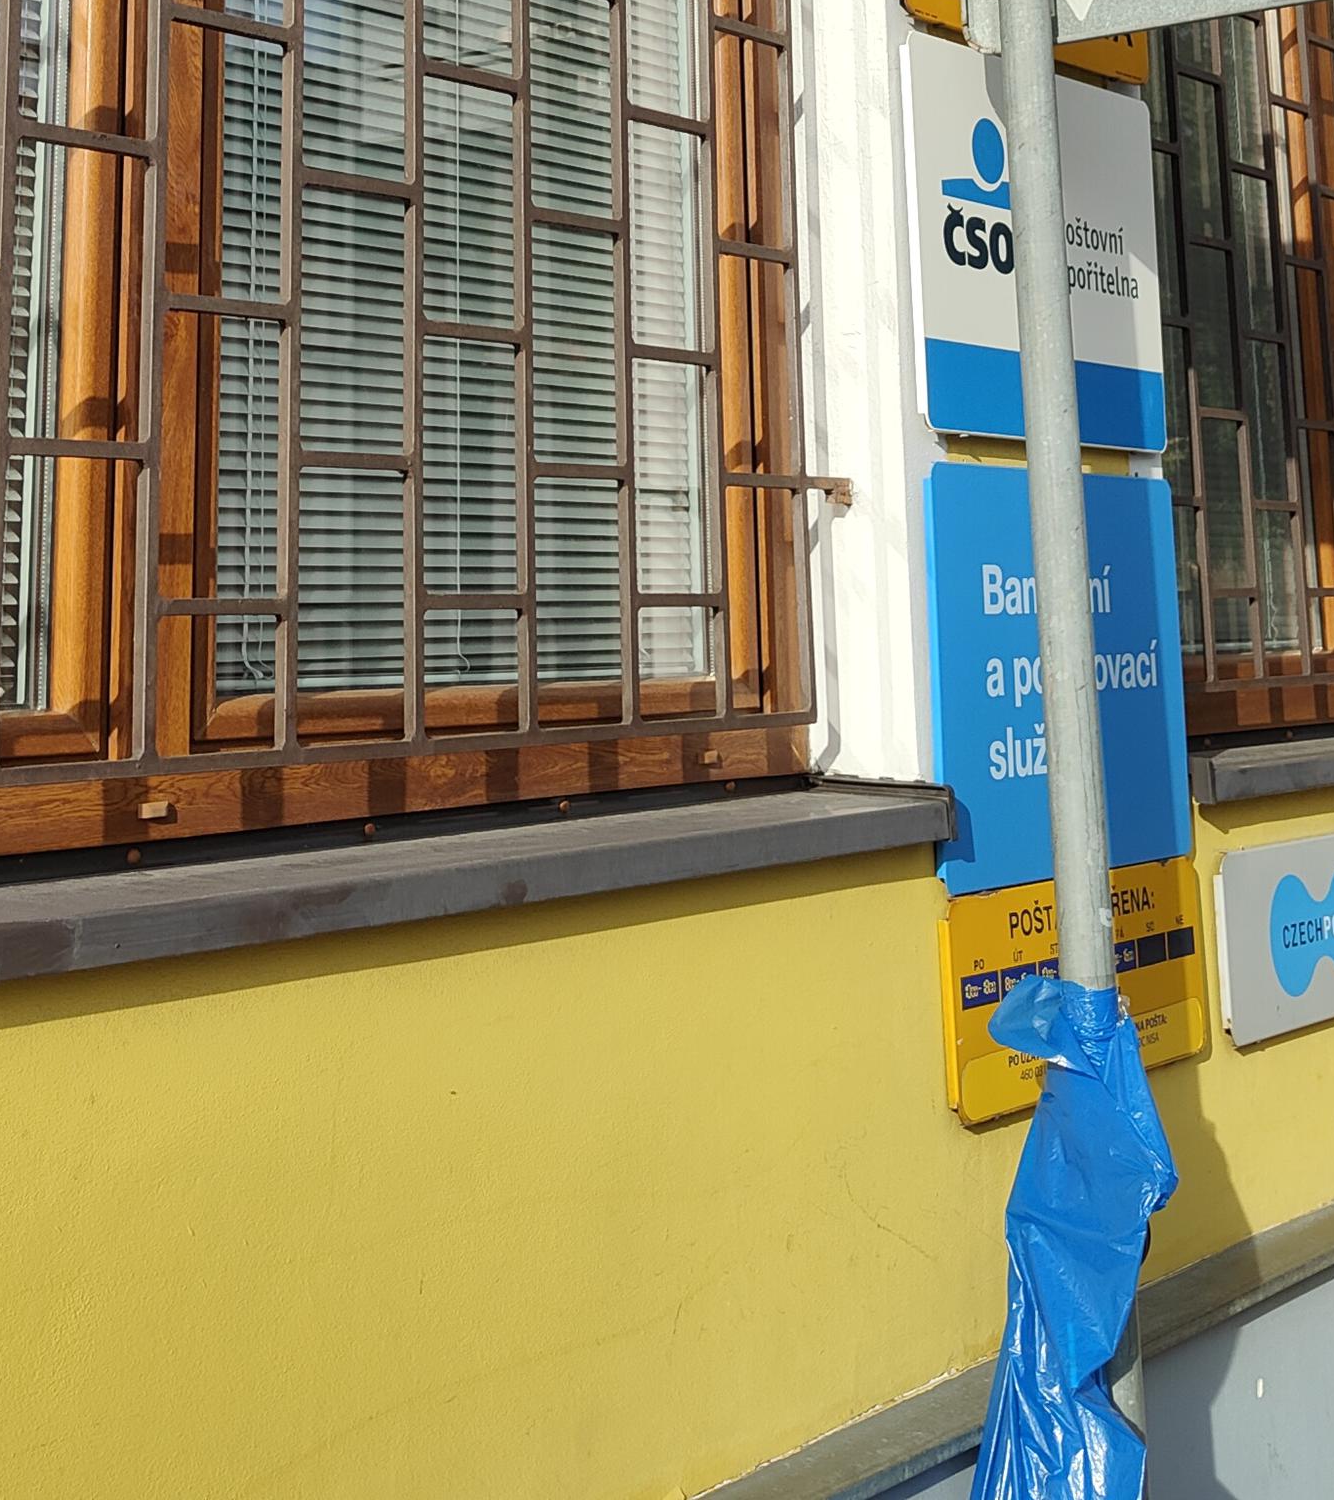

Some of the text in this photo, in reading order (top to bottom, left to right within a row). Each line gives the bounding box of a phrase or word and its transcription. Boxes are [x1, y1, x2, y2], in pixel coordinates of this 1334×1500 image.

[943, 203, 1015, 275] ČSO
[1066, 216, 1124, 256] oštovní
[1067, 261, 1139, 300] pořitelna
[982, 564, 1111, 616] Banní
[986, 639, 1158, 708] a poovací
[989, 723, 1048, 781] služ
[1009, 885, 1155, 939] POŠT ŘENA:
[974, 959, 985, 971] PO
[1013, 948, 1023, 962] ÚT
[1008, 1054, 1020, 1068] PO
